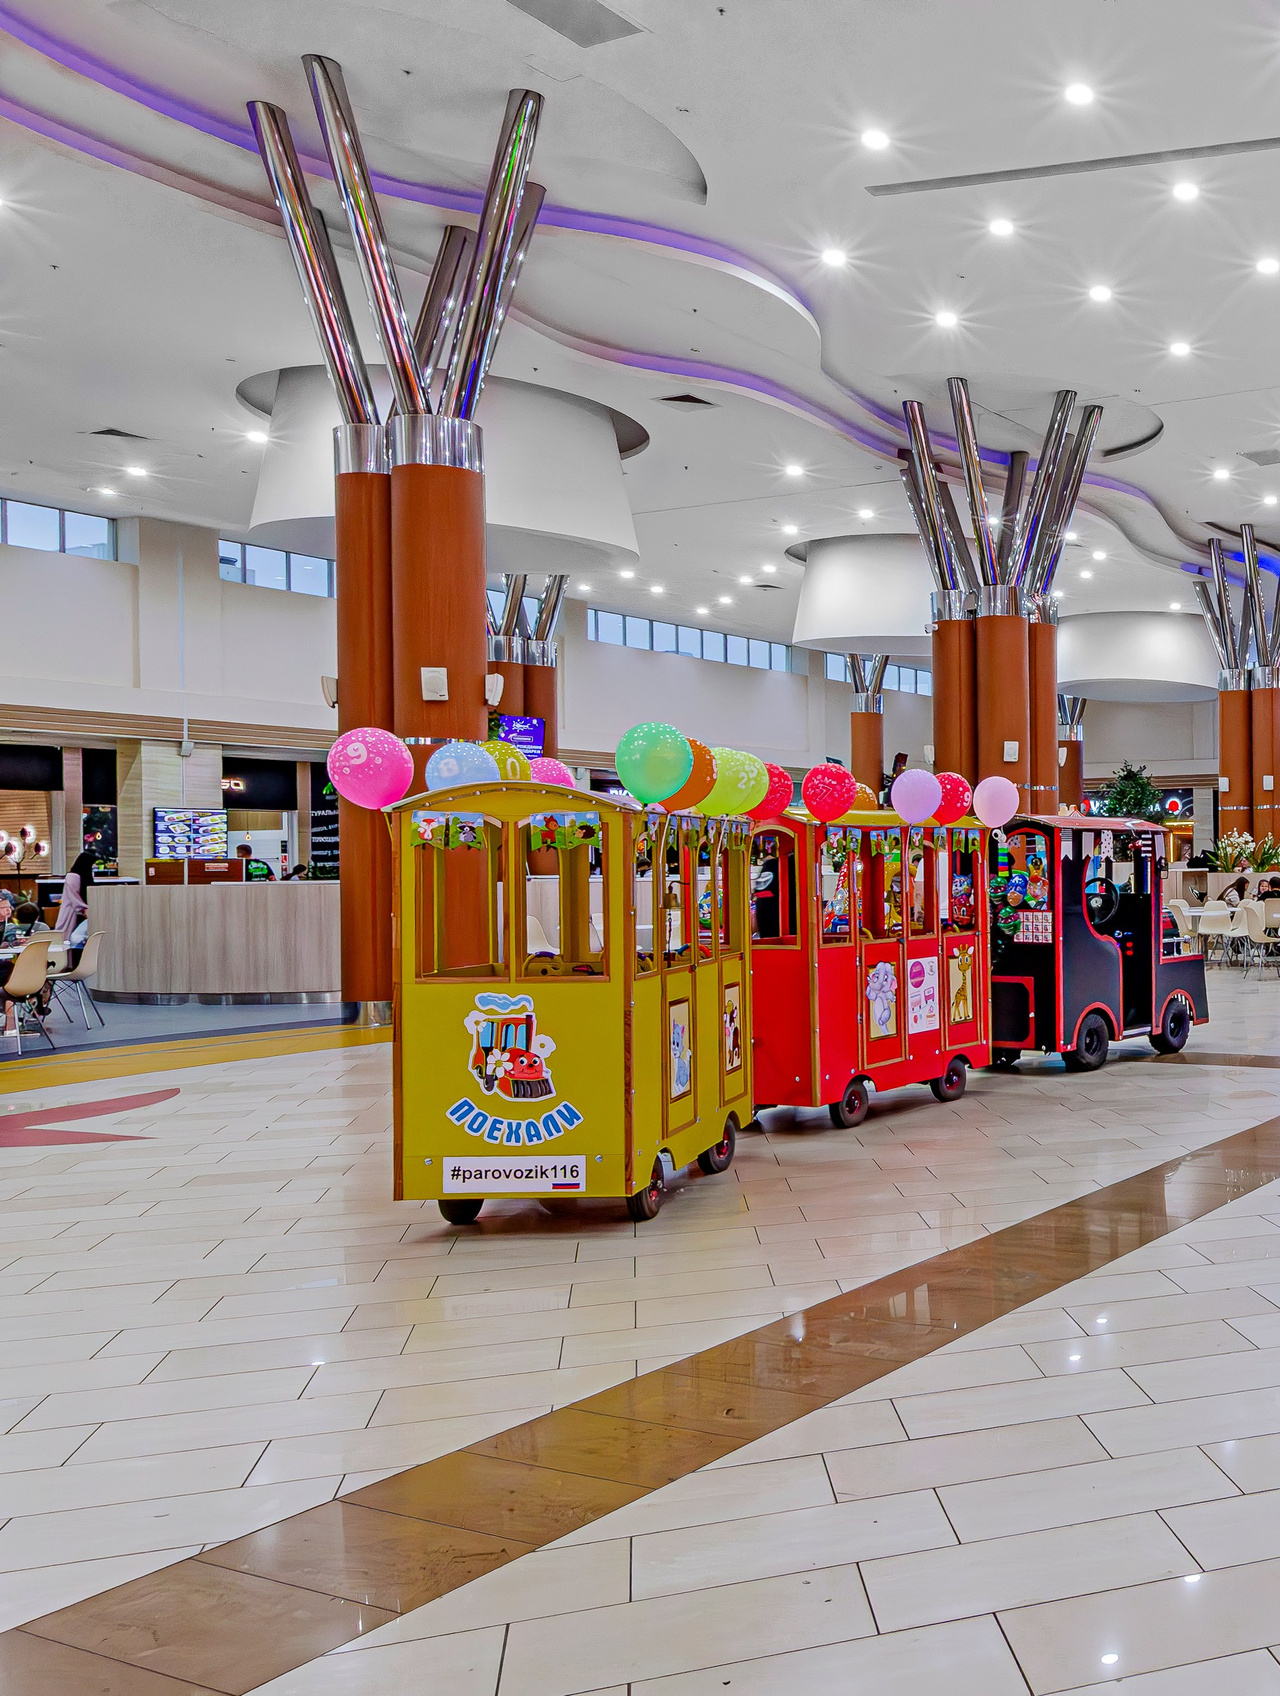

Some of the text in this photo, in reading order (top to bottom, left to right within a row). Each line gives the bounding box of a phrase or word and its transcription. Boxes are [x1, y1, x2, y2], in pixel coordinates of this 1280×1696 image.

[347, 742, 367, 765] 9
[448, 1098, 583, 1145] ПОЕХАЛИ
[451, 1164, 580, 1183] #parovozik116
